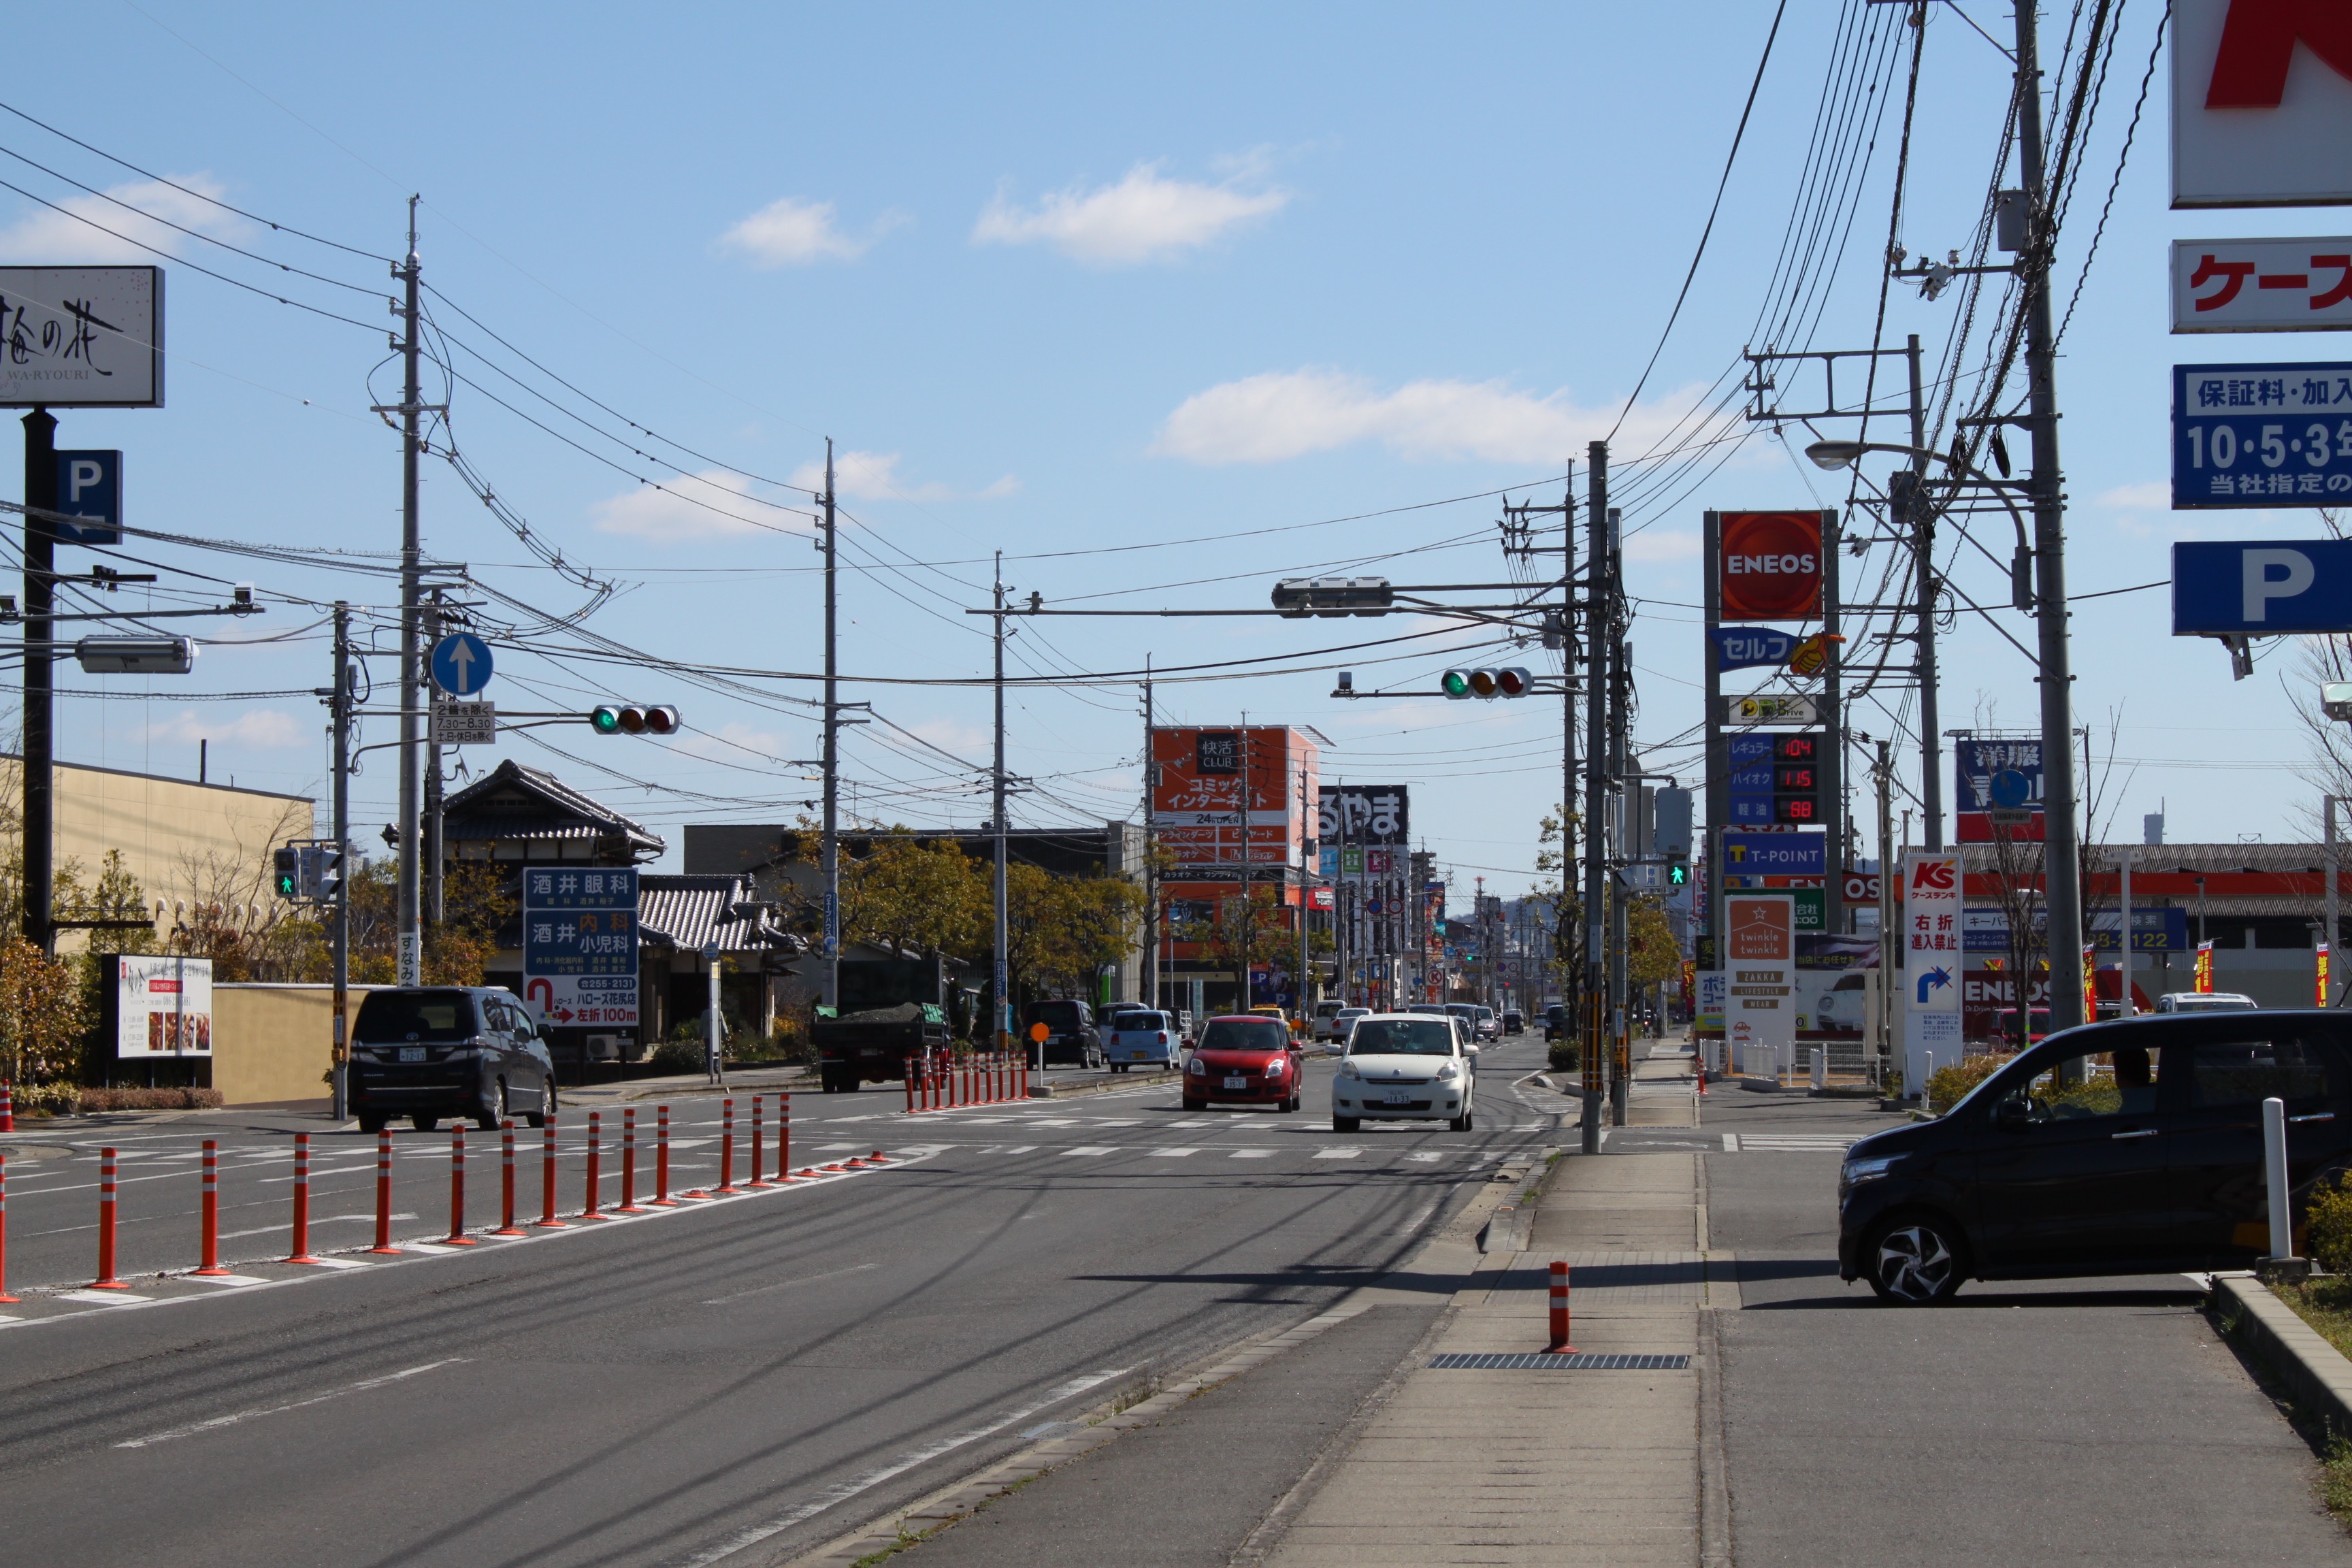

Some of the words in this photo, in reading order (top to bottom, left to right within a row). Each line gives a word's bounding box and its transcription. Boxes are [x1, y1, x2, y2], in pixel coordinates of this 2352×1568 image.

[71, 460, 102, 502] P
[2210, 474, 2352, 495] 当社指定の
[1728, 555, 1815, 574] ENEOS
[2242, 549, 2315, 621] P
[1723, 637, 1787, 659] セルフ
[438, 704, 489, 715] 2輪を除く
[1203, 741, 1232, 755] 快活
[1732, 742, 1771, 753] レギュラー
[1786, 740, 1811, 756] 104
[1203, 757, 1232, 768] CLUB
[1974, 745, 2040, 766] 洋服
[1733, 773, 1770, 784] ハイオク
[1786, 771, 1811, 786] 115
[1168, 794, 1267, 808] インターネト
[1738, 803, 1767, 816] 軽油
[1791, 801, 1811, 817] 88
[1232, 830, 1273, 838] ビヤード
[1751, 851, 1818, 862] T-POINT
[534, 875, 629, 894] 酒井眼科
[580, 913, 629, 932] 内科
[1915, 915, 1953, 931] 右折
[2130, 915, 2157, 926] 検索
[534, 924, 576, 943] 酒井
[1741, 930, 1778, 941] twinkle
[580, 936, 629, 953] 小児科
[1741, 943, 1778, 954] twinkle
[1912, 934, 1957, 951] 進入禁止
[402, 936, 413, 987] すなみ
[1259, 974, 1267, 983] P
[1744, 973, 1776, 981] ZAKKA
[577, 992, 636, 1005] ハローズ花尻店
[1276, 994, 1286, 1005] P
[577, 1008, 600, 1022] 左折
[603, 1008, 636, 1022] 100m
